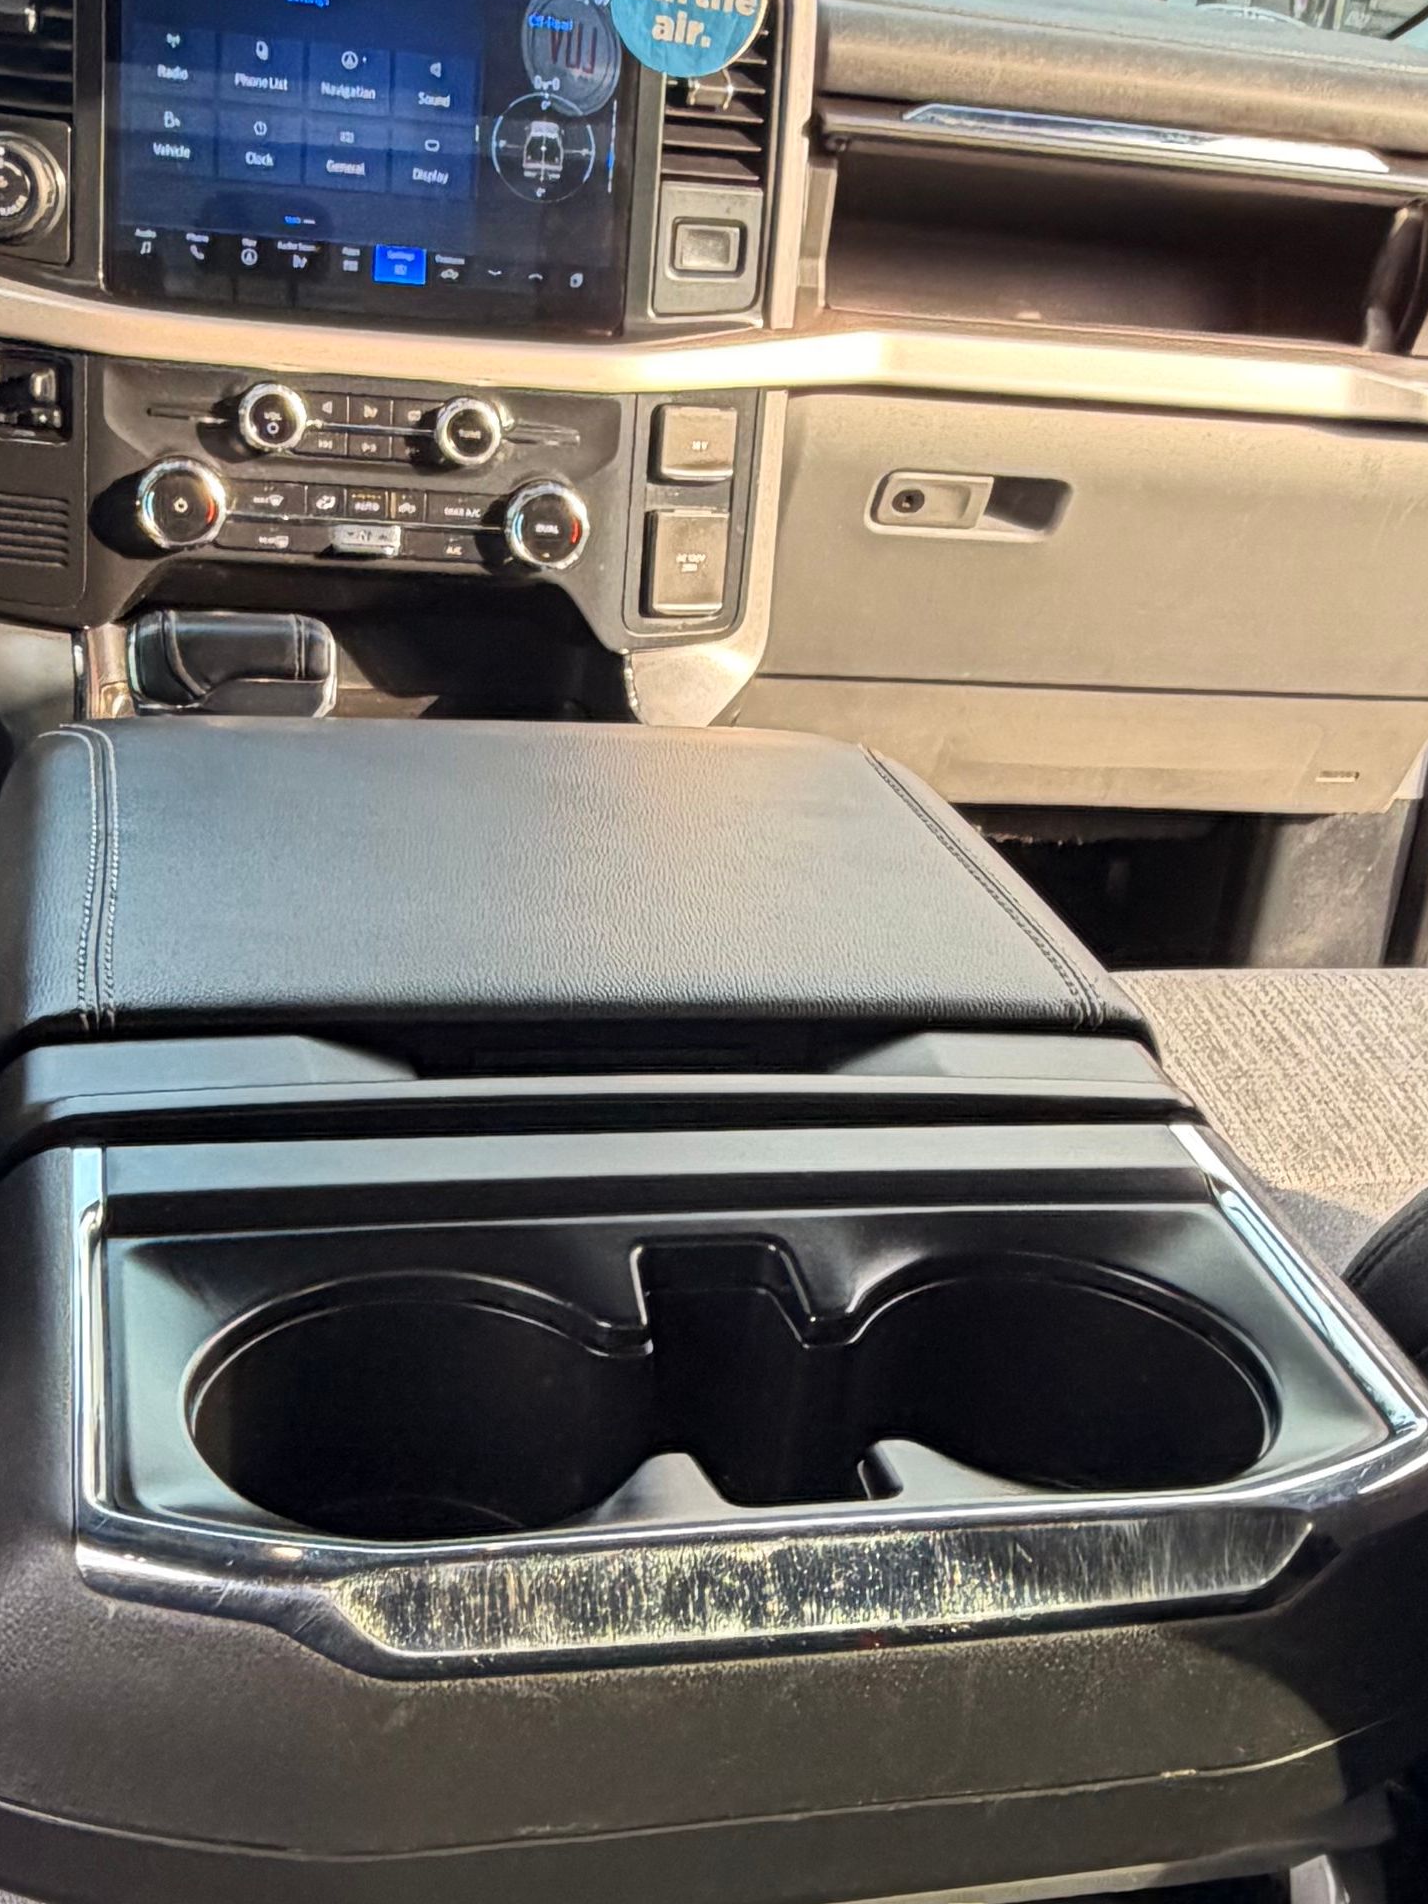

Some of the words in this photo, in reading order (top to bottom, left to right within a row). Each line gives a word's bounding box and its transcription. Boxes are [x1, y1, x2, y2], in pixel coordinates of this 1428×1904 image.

[652, 11, 711, 48] air.
[157, 64, 188, 81] Radio
[234, 72, 268, 90] Phone
[269, 74, 288, 92] List
[321, 80, 376, 100] Navigation
[418, 91, 450, 108] Sound
[153, 142, 191, 159] Vehicle
[245, 151, 274, 167] Clock
[326, 159, 366, 177] General
[412, 167, 449, 185] Display
